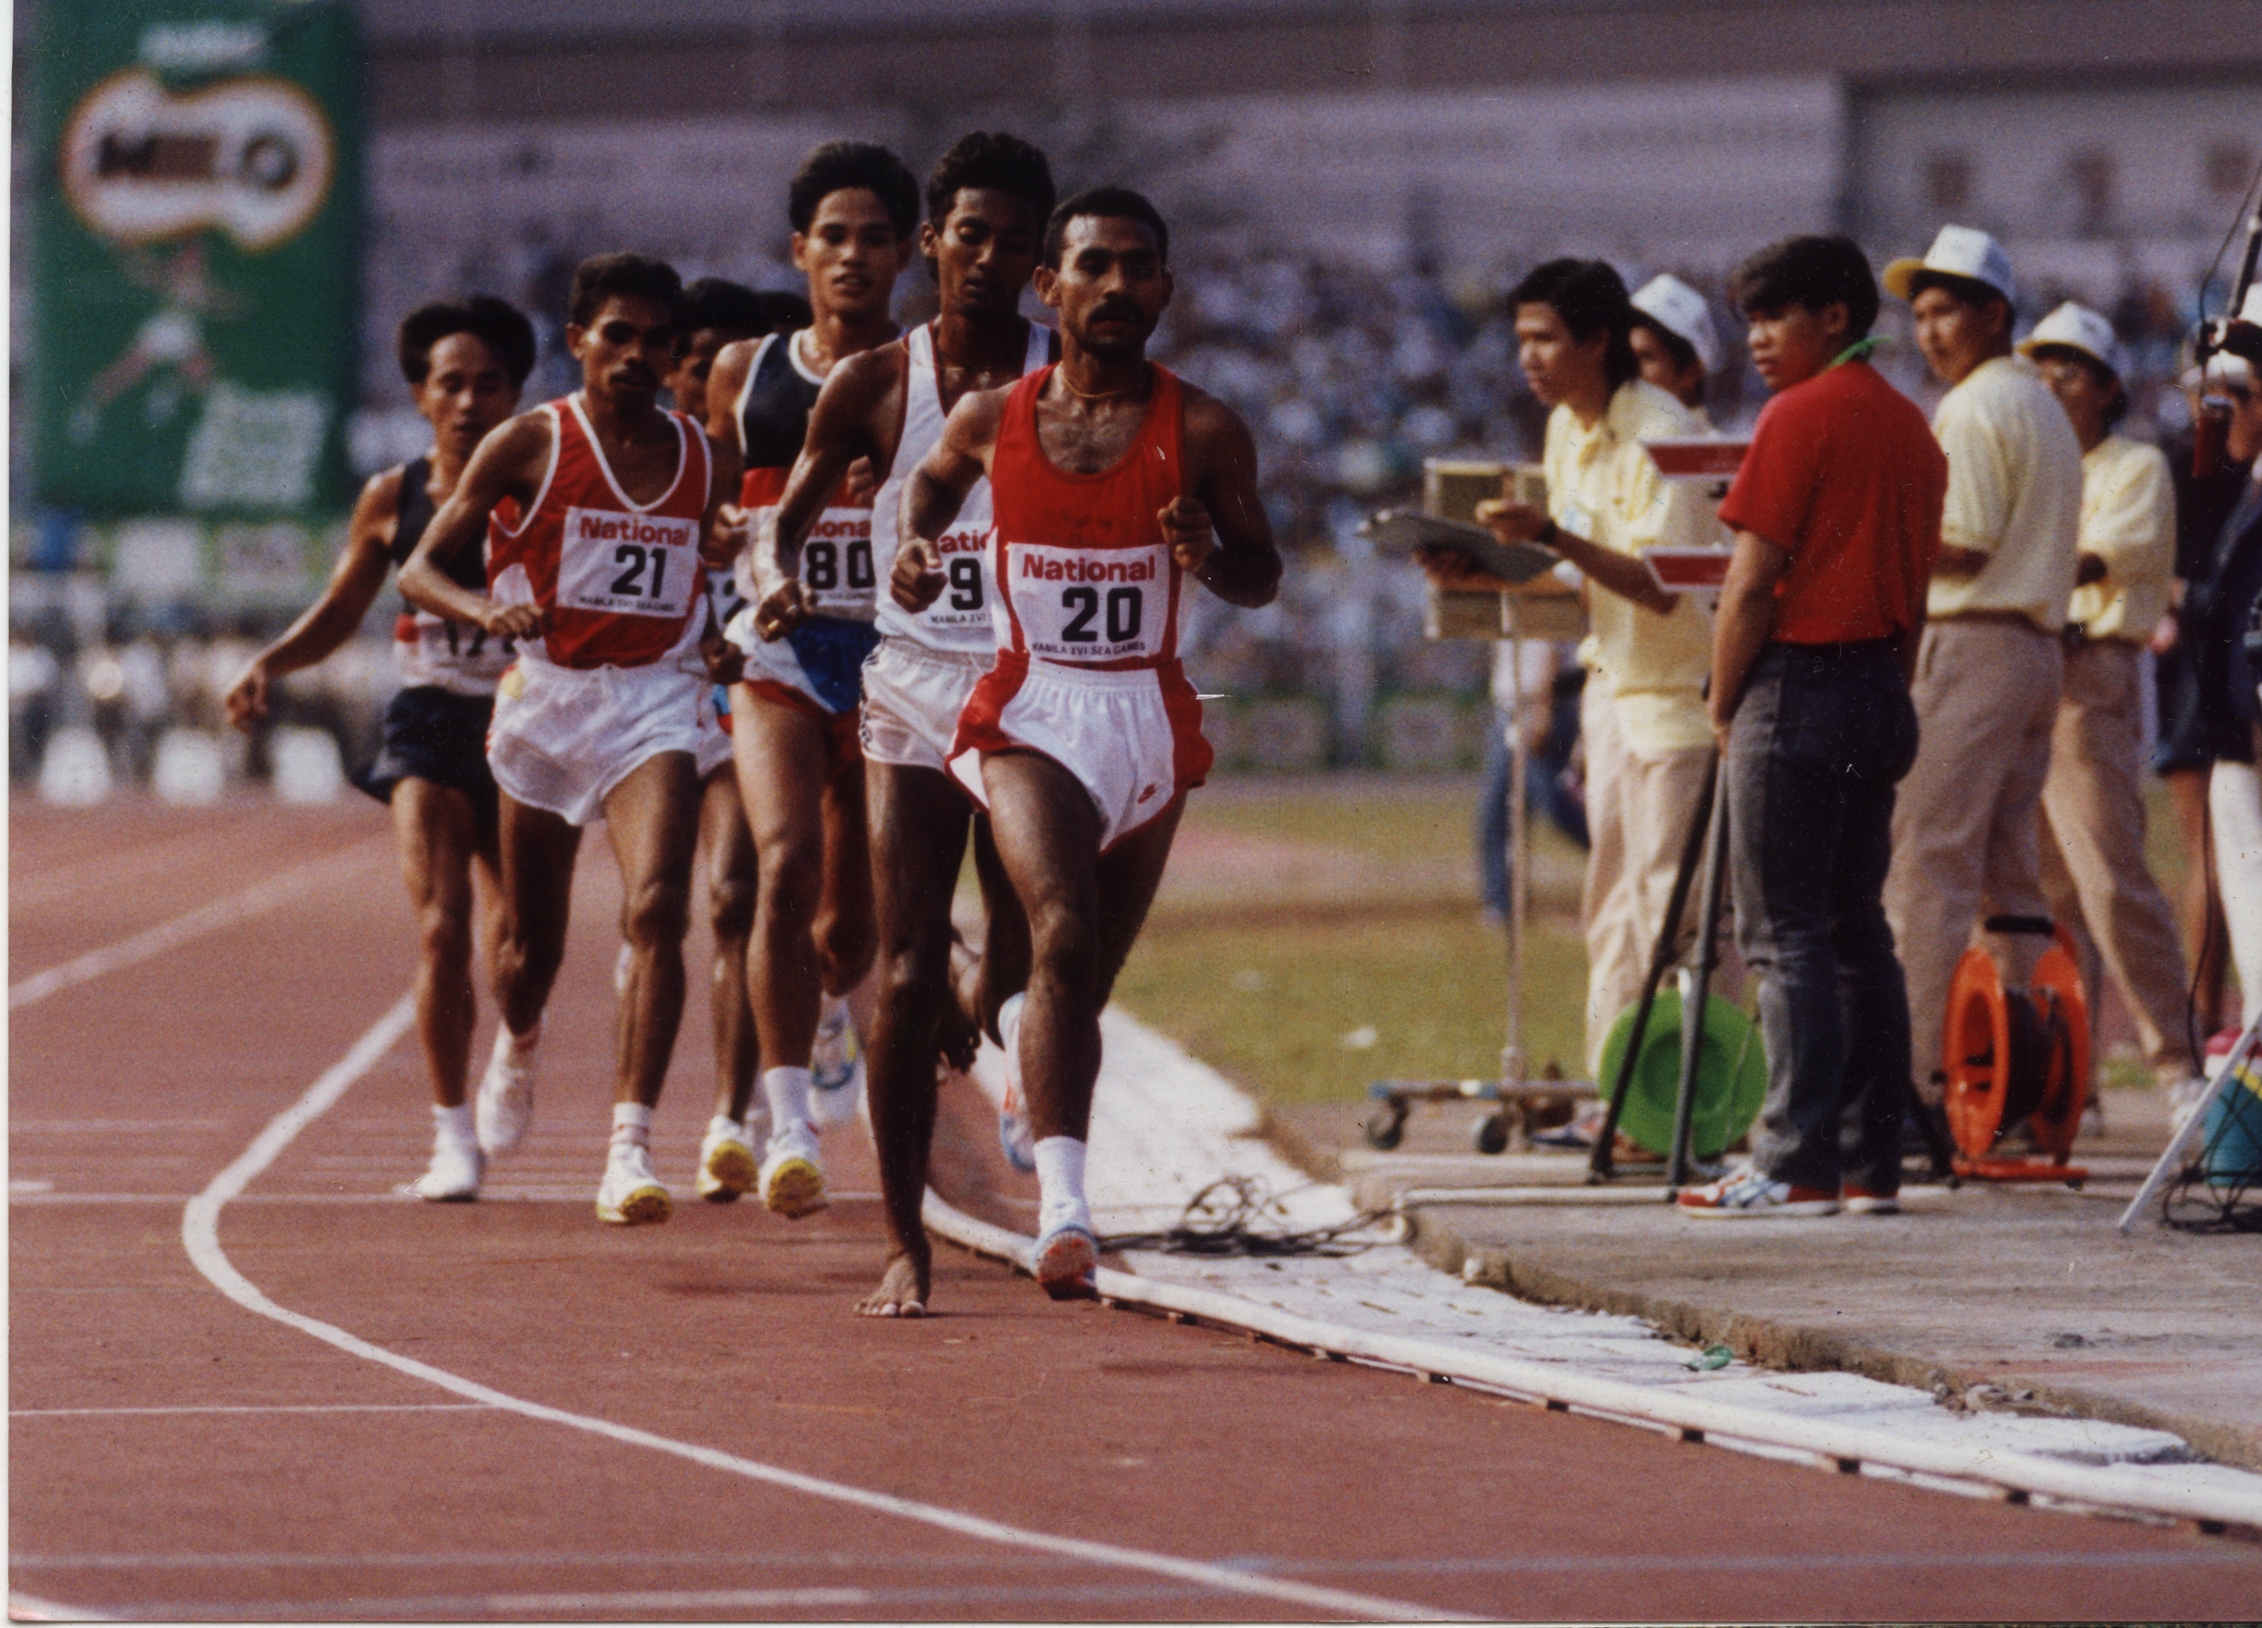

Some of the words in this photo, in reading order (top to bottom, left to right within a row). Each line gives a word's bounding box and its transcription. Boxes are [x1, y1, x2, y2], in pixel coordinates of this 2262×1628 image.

[580, 516, 690, 547] National
[611, 544, 667, 598] 21
[806, 541, 876, 590] 80
[1022, 553, 1156, 582] National
[1061, 586, 1143, 643] 20
[1031, 642, 1068, 654] MANILA
[1070, 646, 1088, 656] XVI
[1091, 645, 1111, 655] SEA
[1113, 641, 1146, 655] GAMES
